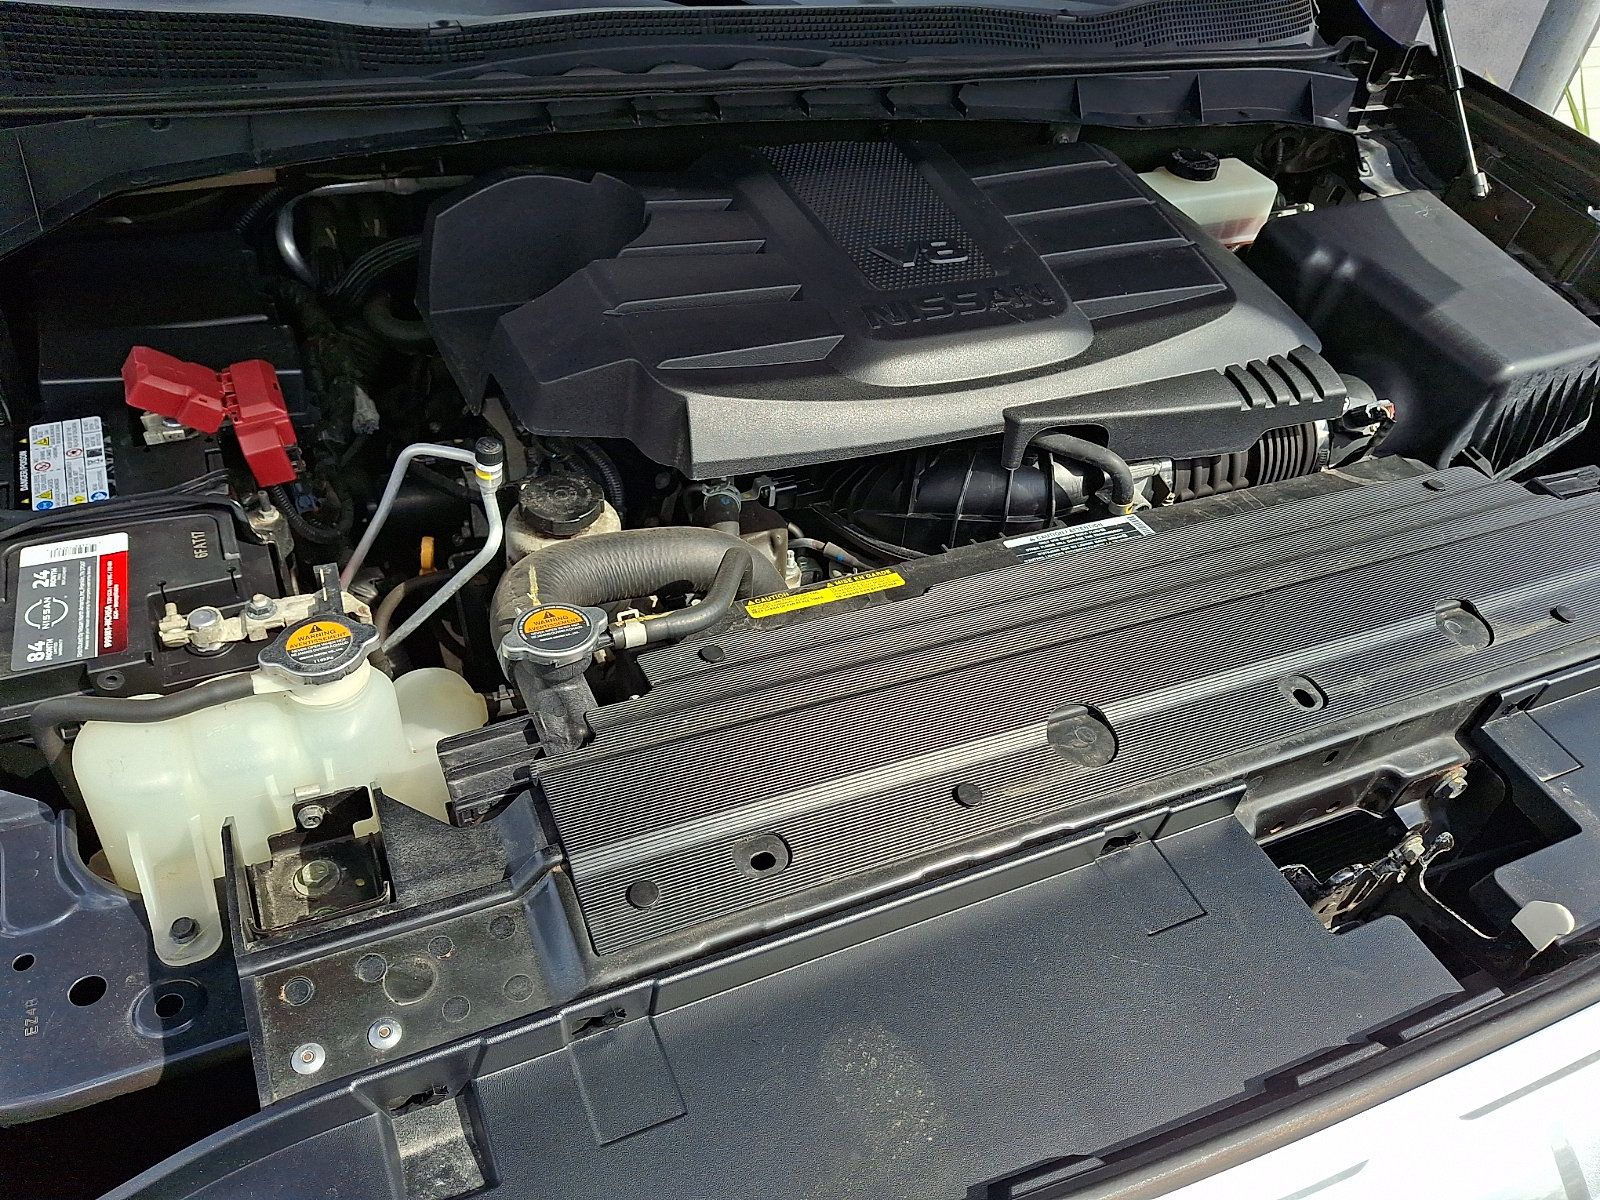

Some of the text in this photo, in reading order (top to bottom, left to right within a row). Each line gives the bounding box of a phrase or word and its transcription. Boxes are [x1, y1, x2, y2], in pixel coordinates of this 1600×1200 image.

[859, 284, 1056, 329] NISSAN
[190, 531, 208, 559] 6FAT17
[32, 569, 50, 589] 24
[754, 592, 789, 603] CAUTION
[42, 597, 52, 630] NISSAN
[533, 615, 569, 625] WARNING
[297, 629, 336, 641] WARNING
[27, 640, 45, 663] 84
